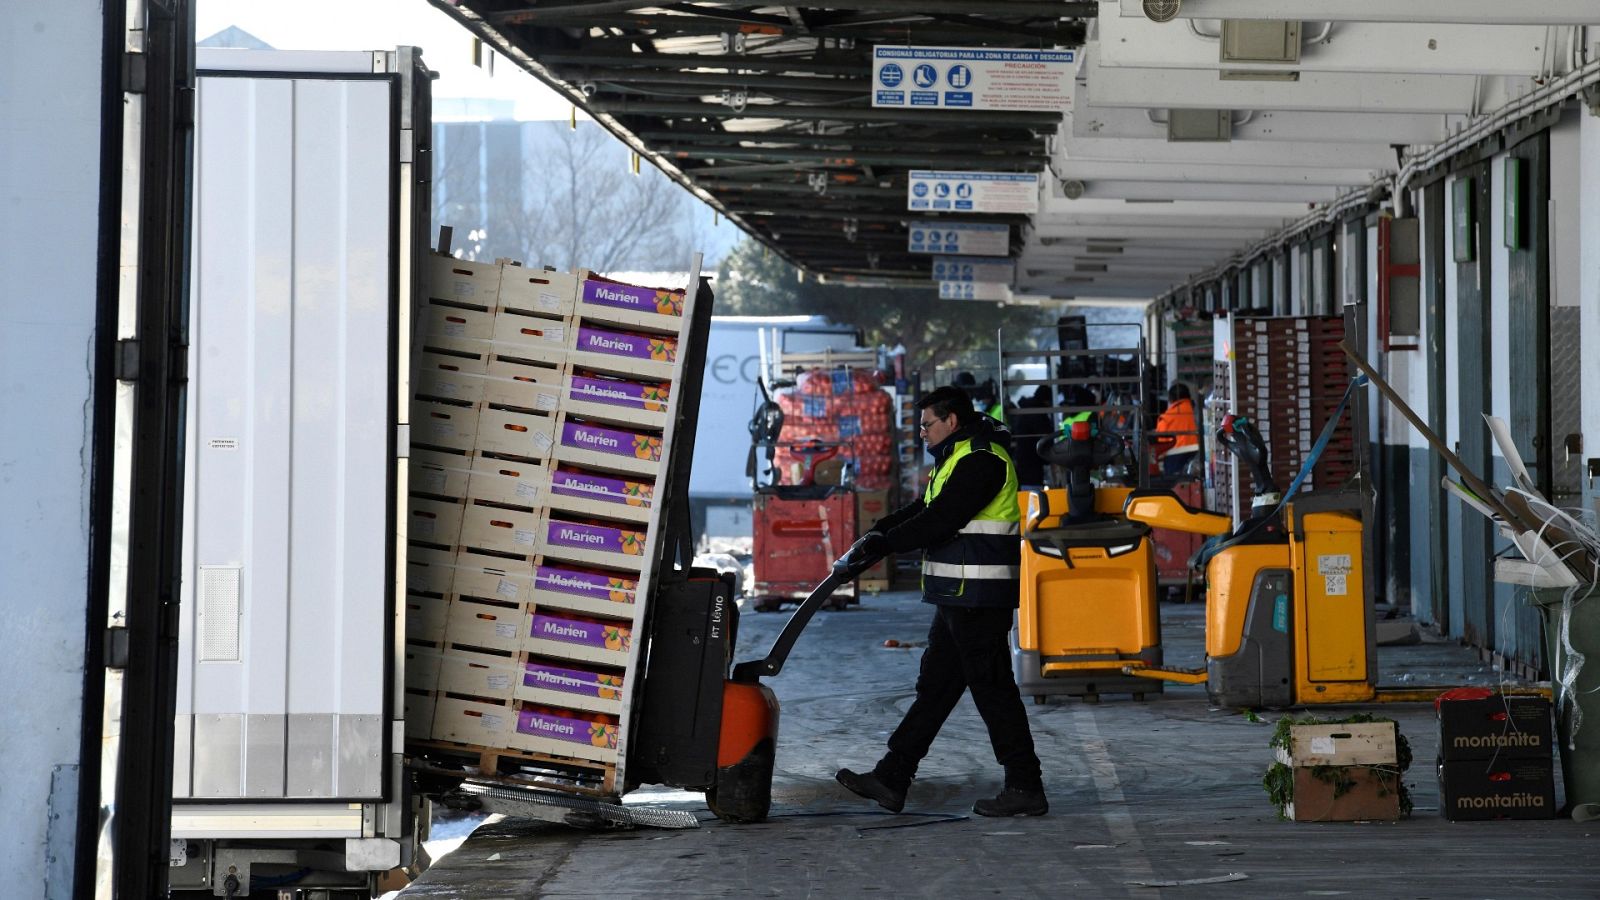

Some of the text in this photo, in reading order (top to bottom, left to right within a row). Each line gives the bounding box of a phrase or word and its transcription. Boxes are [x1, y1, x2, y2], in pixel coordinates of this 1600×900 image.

[878, 49, 913, 58] CONSIGNAS
[914, 50, 958, 59] OBLIGATORIAS
[985, 52, 1002, 60] ZONA
[1012, 53, 1033, 61] CARGA
[1040, 53, 1073, 62] DESCARGA
[595, 288, 639, 304] Marien
[589, 335, 633, 352] Marien
[583, 384, 627, 399] Marien
[574, 430, 618, 447] Marien
[564, 478, 608, 493] Marien
[560, 529, 604, 545] Marien
[548, 573, 592, 590] Marien
[543, 622, 588, 639] Marien
[536, 670, 581, 688] Marien
[530, 717, 574, 735] Marien
[1453, 731, 1541, 748] montañita
[1457, 792, 1545, 809] montañita
